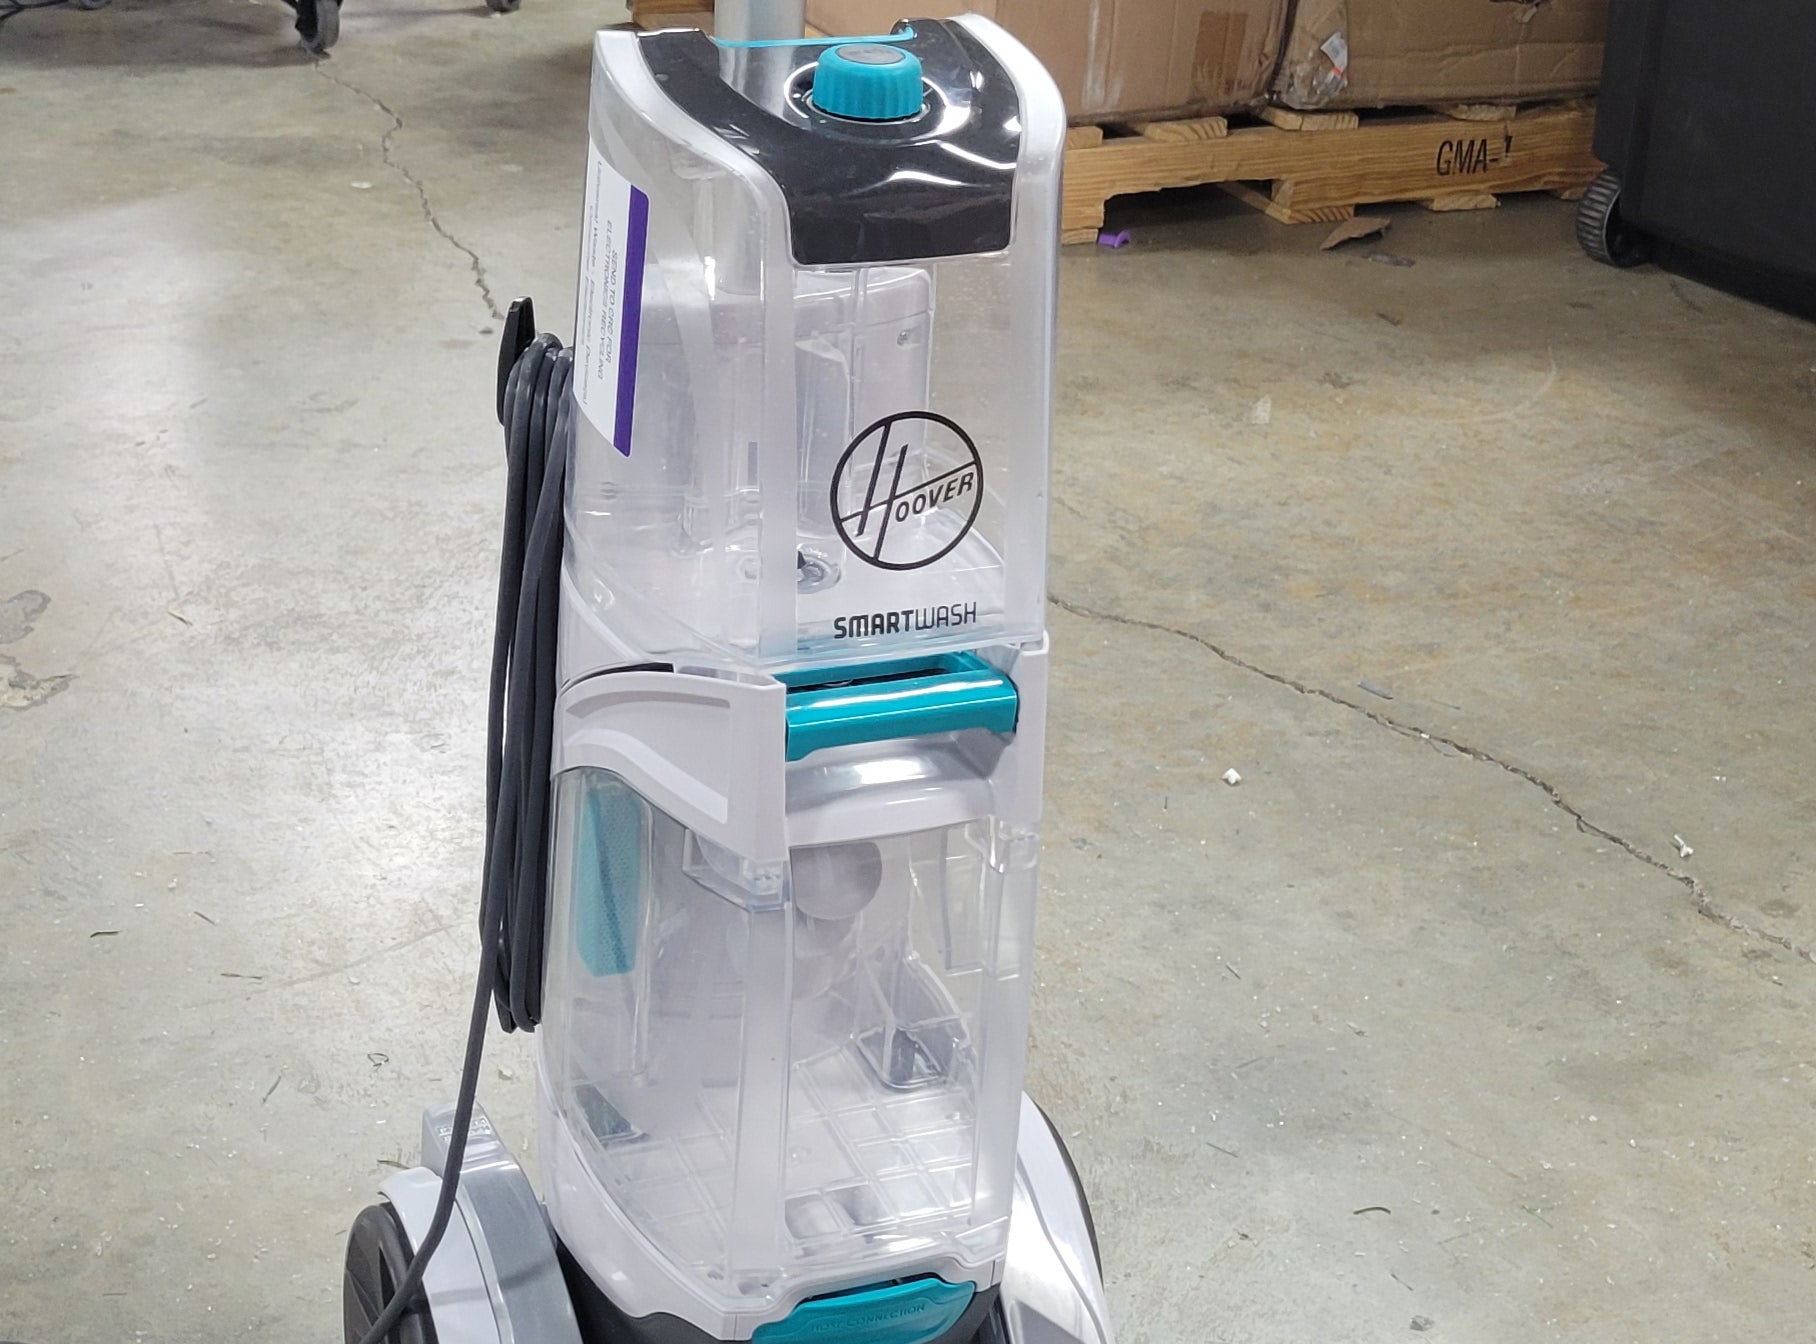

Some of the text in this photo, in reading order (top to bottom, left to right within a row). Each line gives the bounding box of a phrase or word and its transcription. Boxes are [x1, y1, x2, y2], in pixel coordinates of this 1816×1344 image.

[610, 249, 619, 285] SEND
[597, 220, 613, 381] ELECTRONICS RECYCLING
[608, 288, 616, 305] TO
[604, 337, 613, 364] FOR
[833, 601, 977, 640] SMARTWASH
[846, 1302, 926, 1327] CONNECTION
